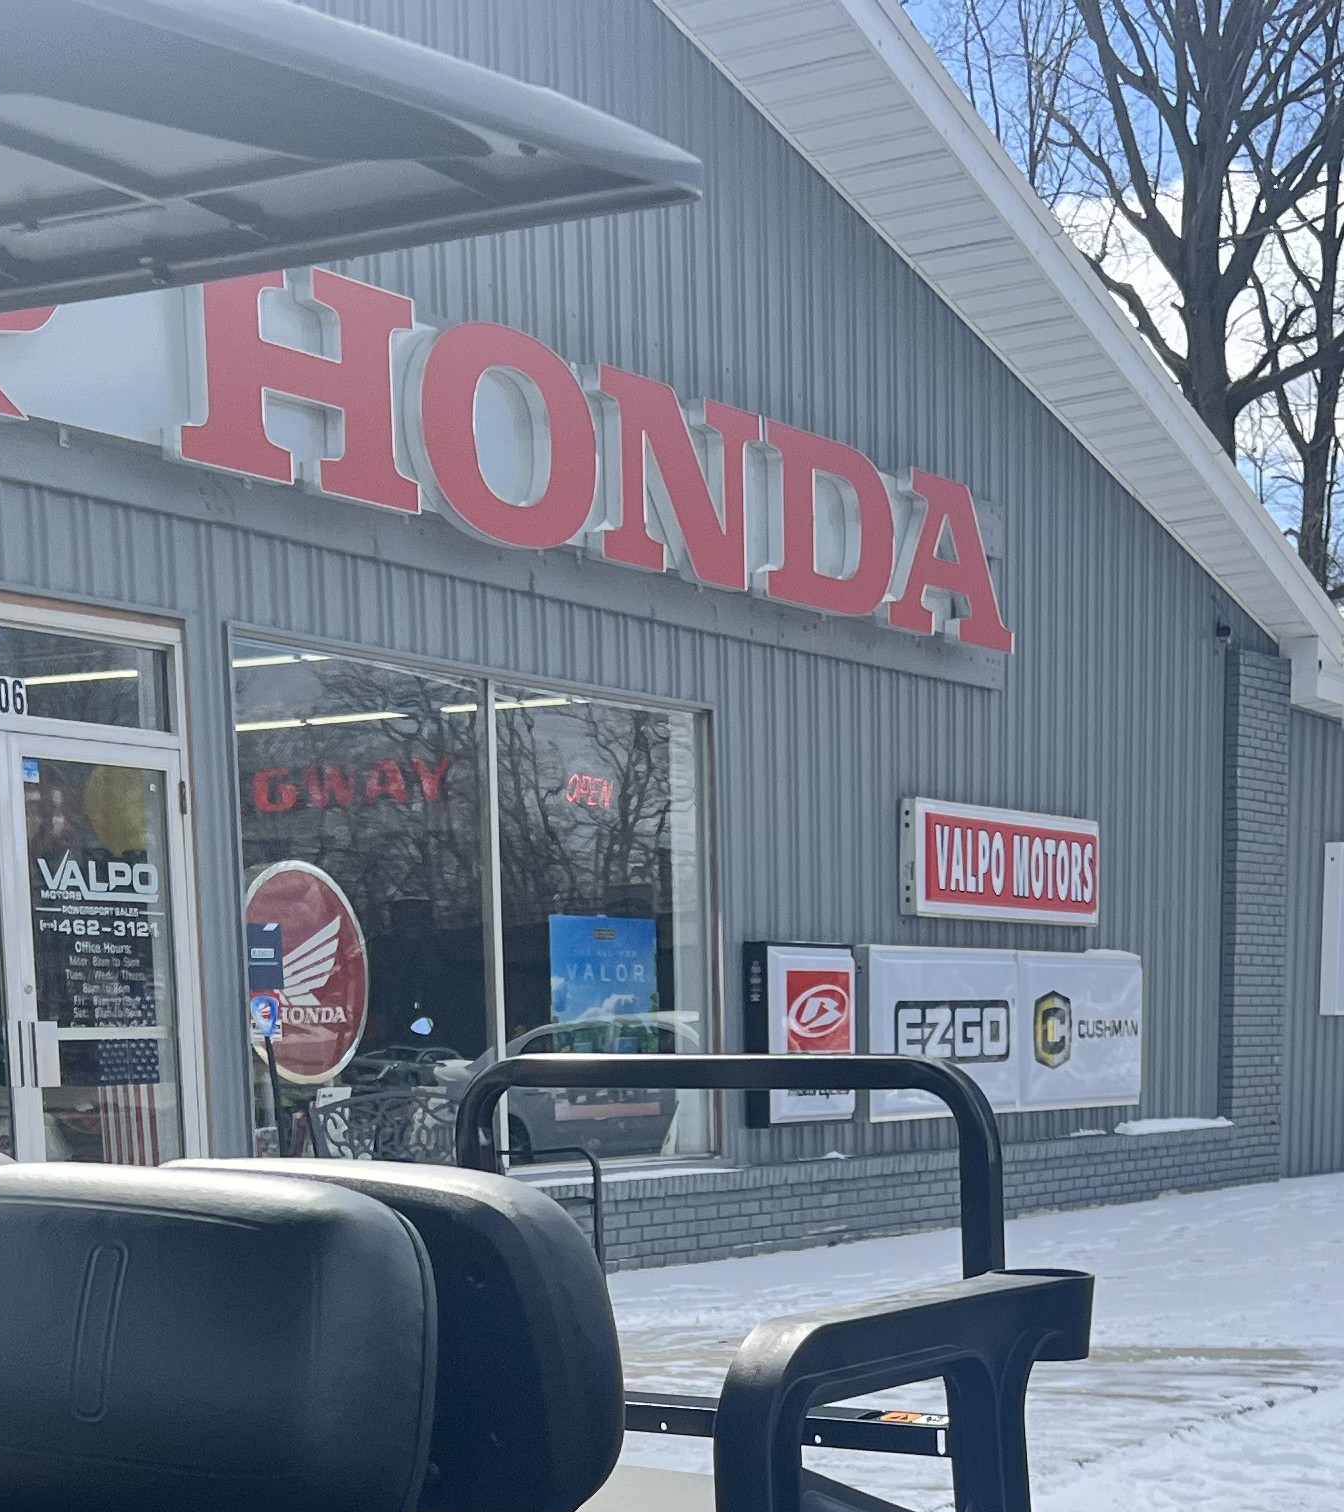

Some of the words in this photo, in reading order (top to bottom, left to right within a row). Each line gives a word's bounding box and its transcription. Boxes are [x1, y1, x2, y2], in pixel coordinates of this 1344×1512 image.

[179, 266, 1014, 654] HONDA
[566, 772, 614, 807] OPEN
[36, 849, 159, 897] VALPO
[935, 823, 1005, 896] VALPO
[1012, 835, 1094, 904] MOTORS
[40, 889, 83, 901] MOTORS
[566, 963, 646, 983] VALOR
[897, 1006, 1009, 1059] EZGO
[1077, 1020, 1139, 1039] CUSHMAN
